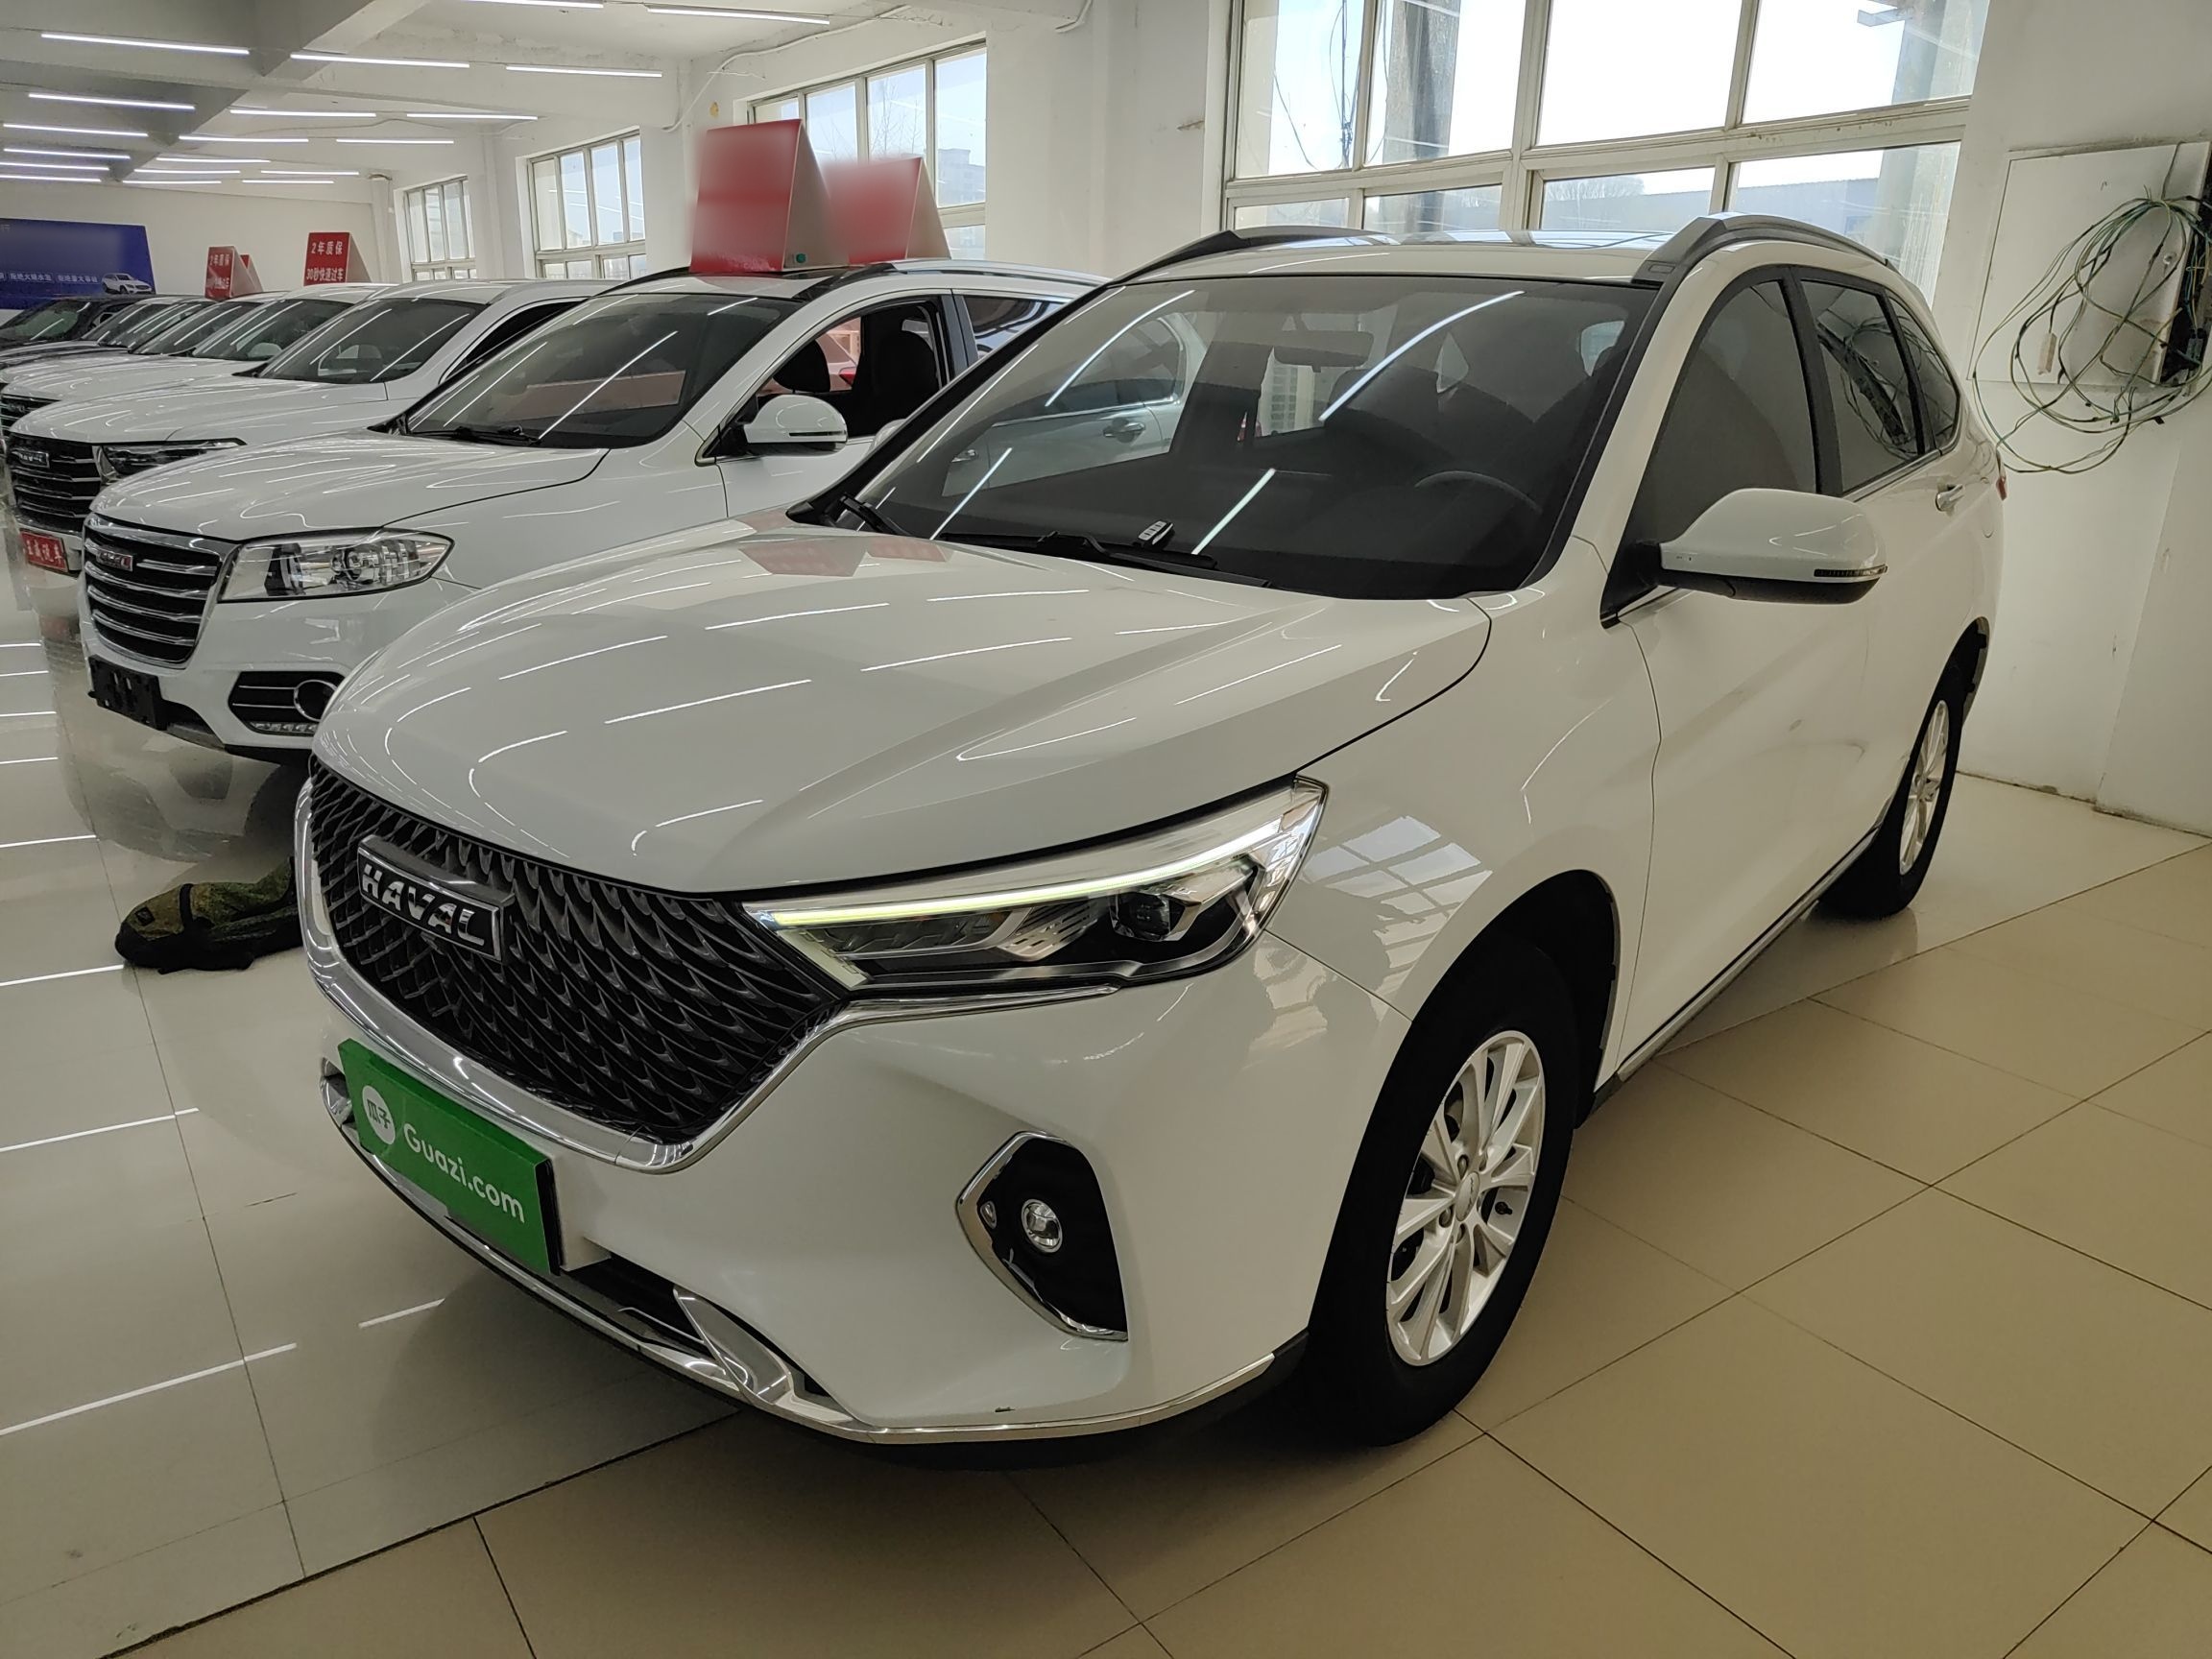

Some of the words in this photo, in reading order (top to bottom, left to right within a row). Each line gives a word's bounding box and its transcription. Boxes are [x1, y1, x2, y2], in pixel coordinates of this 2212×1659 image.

[310, 240, 344, 256] 2年质保
[361, 863, 485, 947] HAVAL
[366, 1098, 392, 1130] 瓜子
[403, 1122, 525, 1224] Guazi.com
